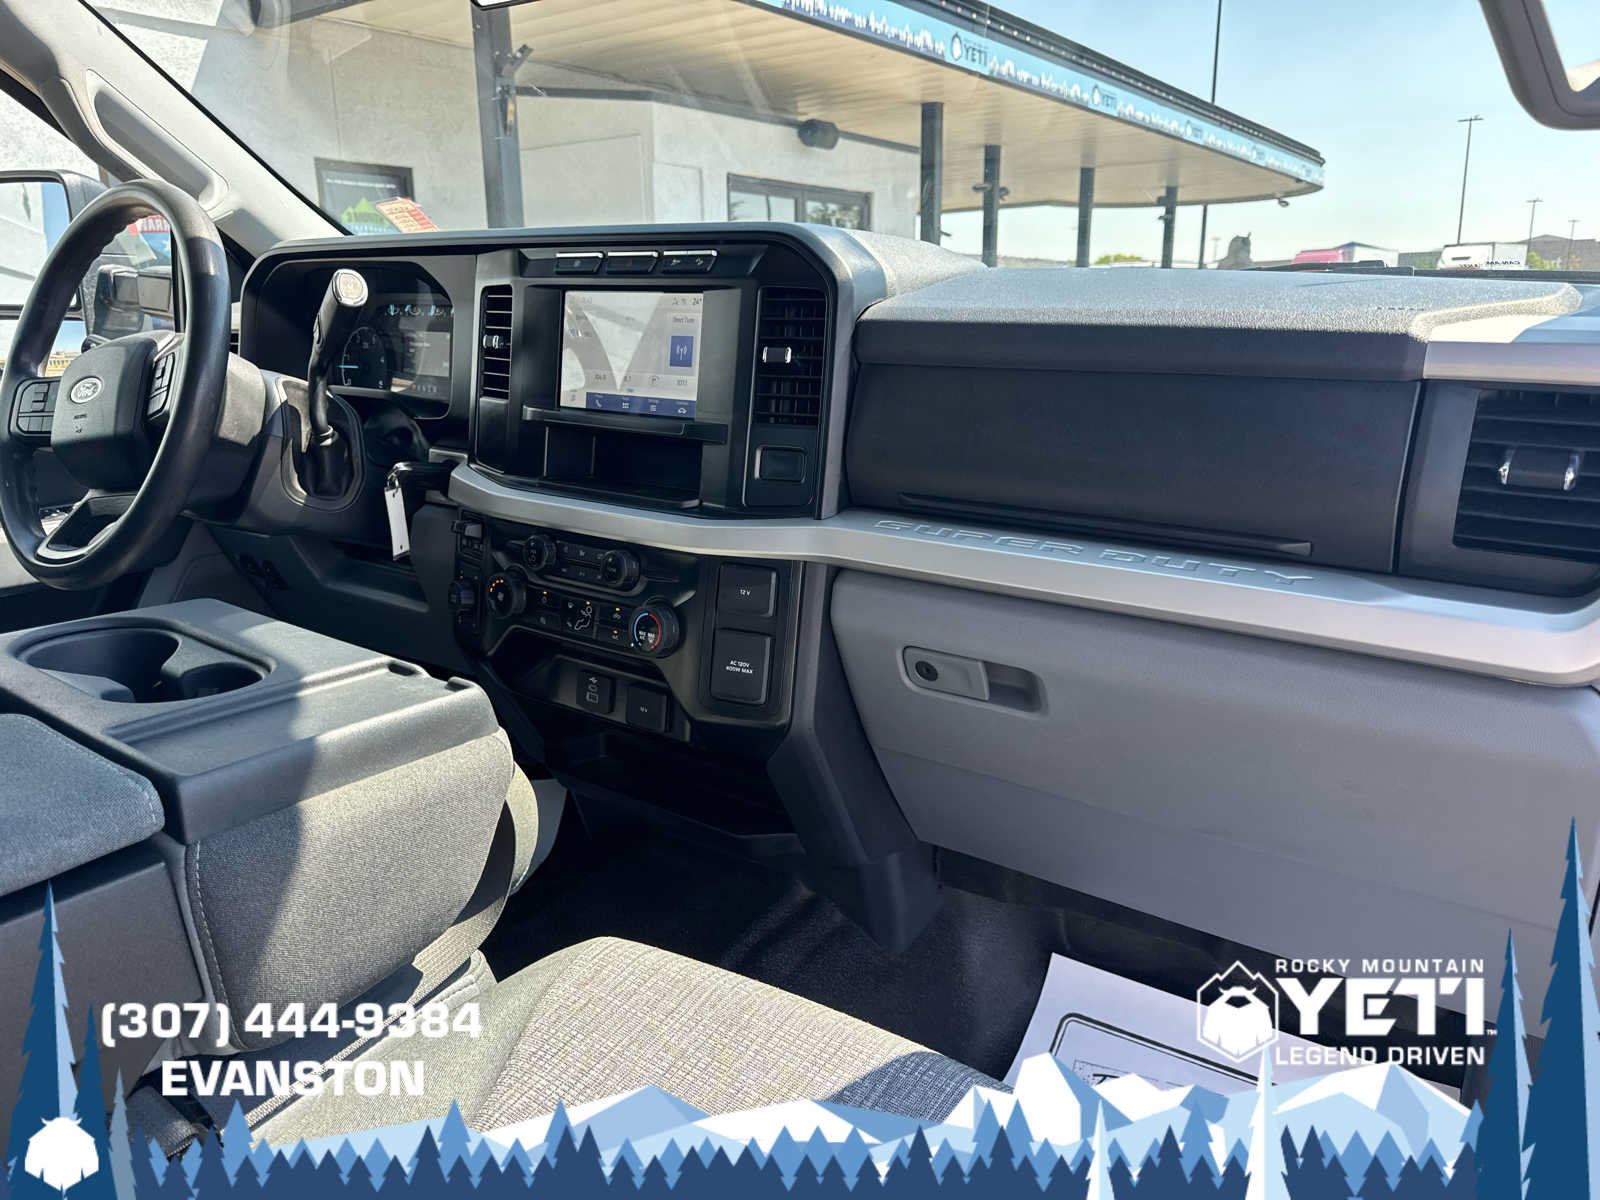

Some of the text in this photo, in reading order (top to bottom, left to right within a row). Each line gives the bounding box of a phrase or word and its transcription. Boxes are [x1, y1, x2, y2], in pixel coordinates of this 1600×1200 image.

[964, 43, 988, 67] YETI
[874, 518, 1315, 585] SUPER DUTY
